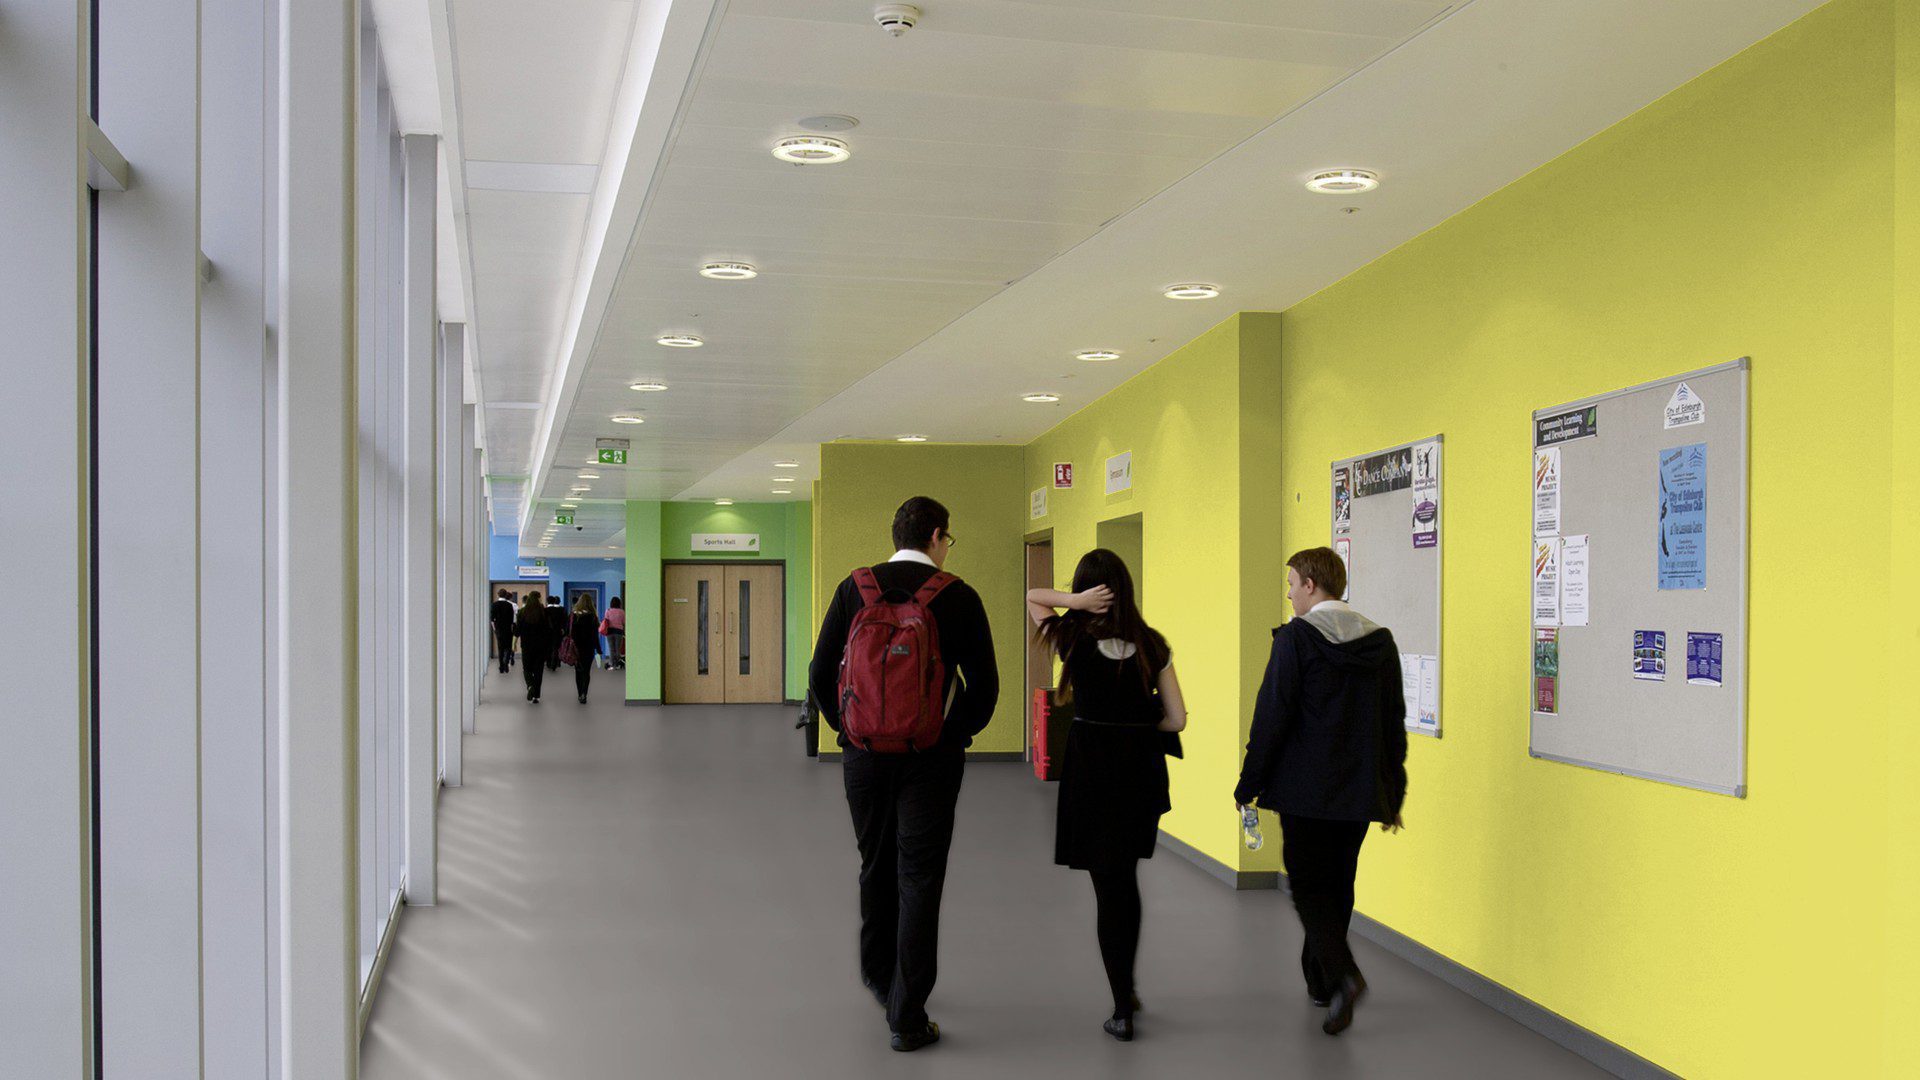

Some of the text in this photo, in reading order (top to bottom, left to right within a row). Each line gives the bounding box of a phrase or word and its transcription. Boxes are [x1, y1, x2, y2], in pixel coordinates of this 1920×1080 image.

[1682, 402, 1702, 413] Edinburgh
[1540, 413, 1583, 431] Community Learning
[1543, 426, 1579, 442] and Development
[1683, 488, 1704, 501] Edinburgh
[1693, 499, 1703, 511] Club
